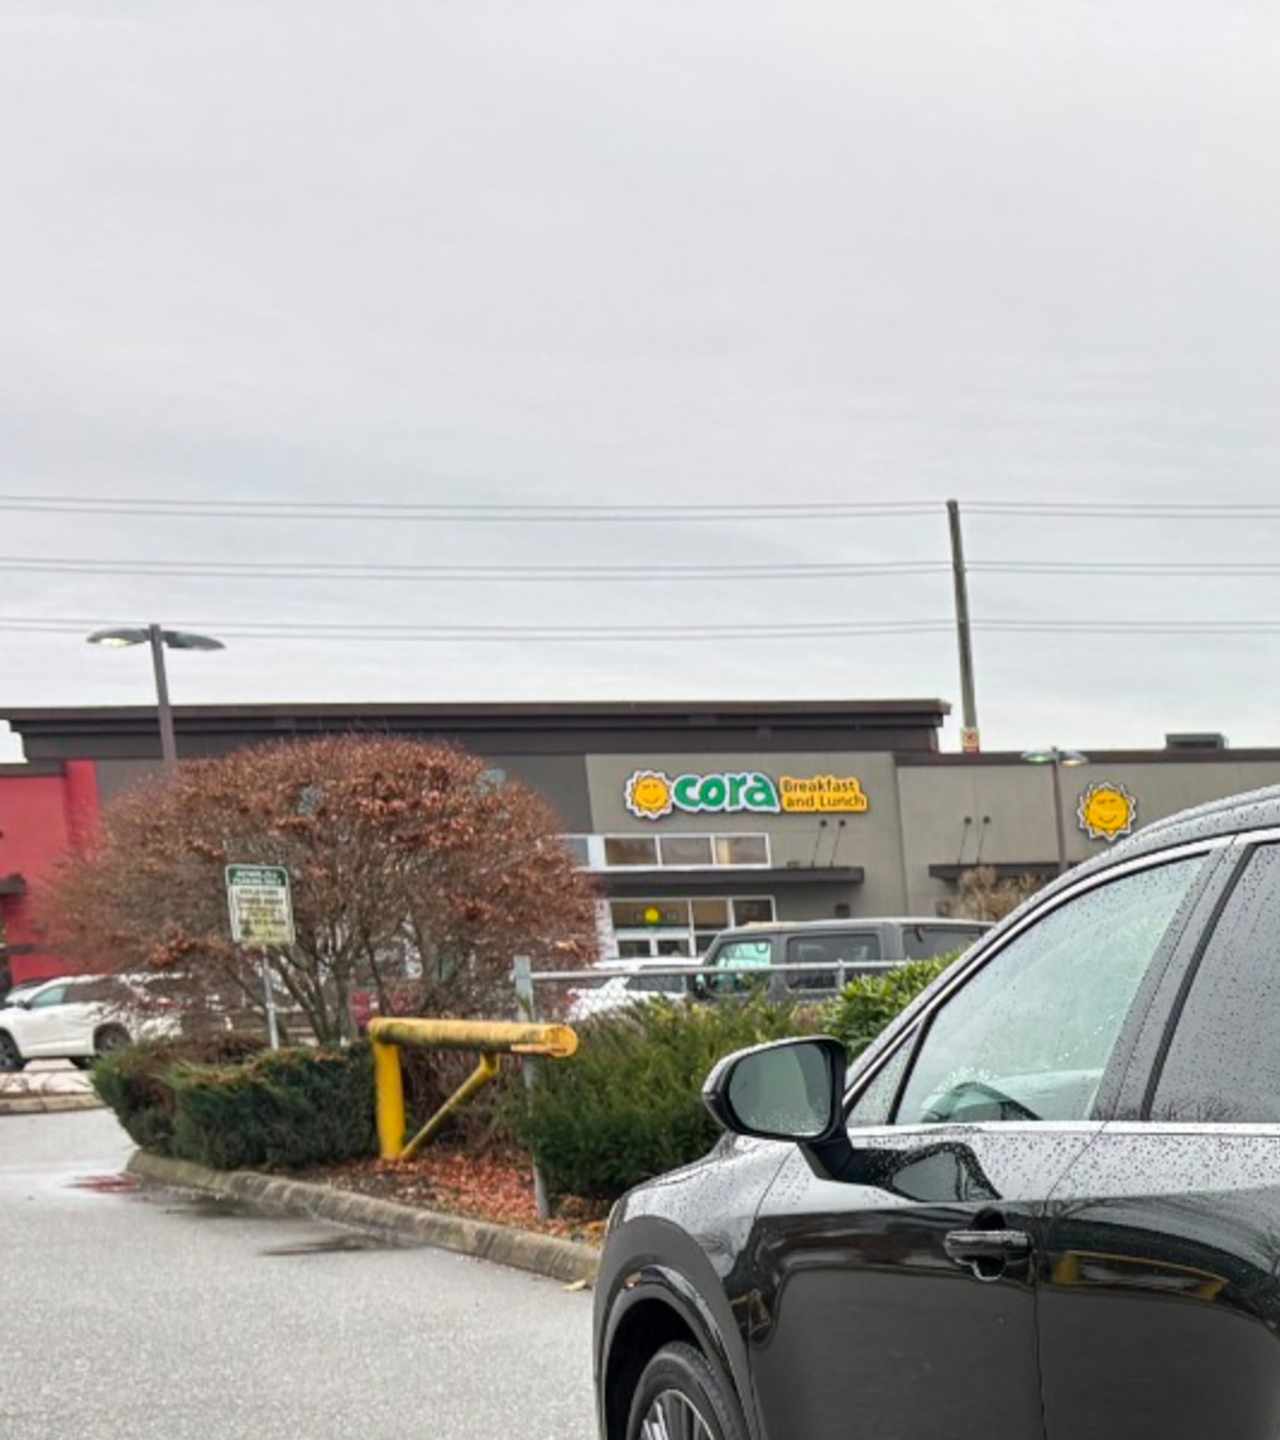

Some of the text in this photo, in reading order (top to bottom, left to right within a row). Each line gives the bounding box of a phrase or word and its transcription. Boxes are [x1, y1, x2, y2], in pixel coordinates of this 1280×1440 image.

[673, 775, 777, 809] cora
[783, 778, 857, 793] Breakfast
[786, 794, 866, 808] and Lunch
